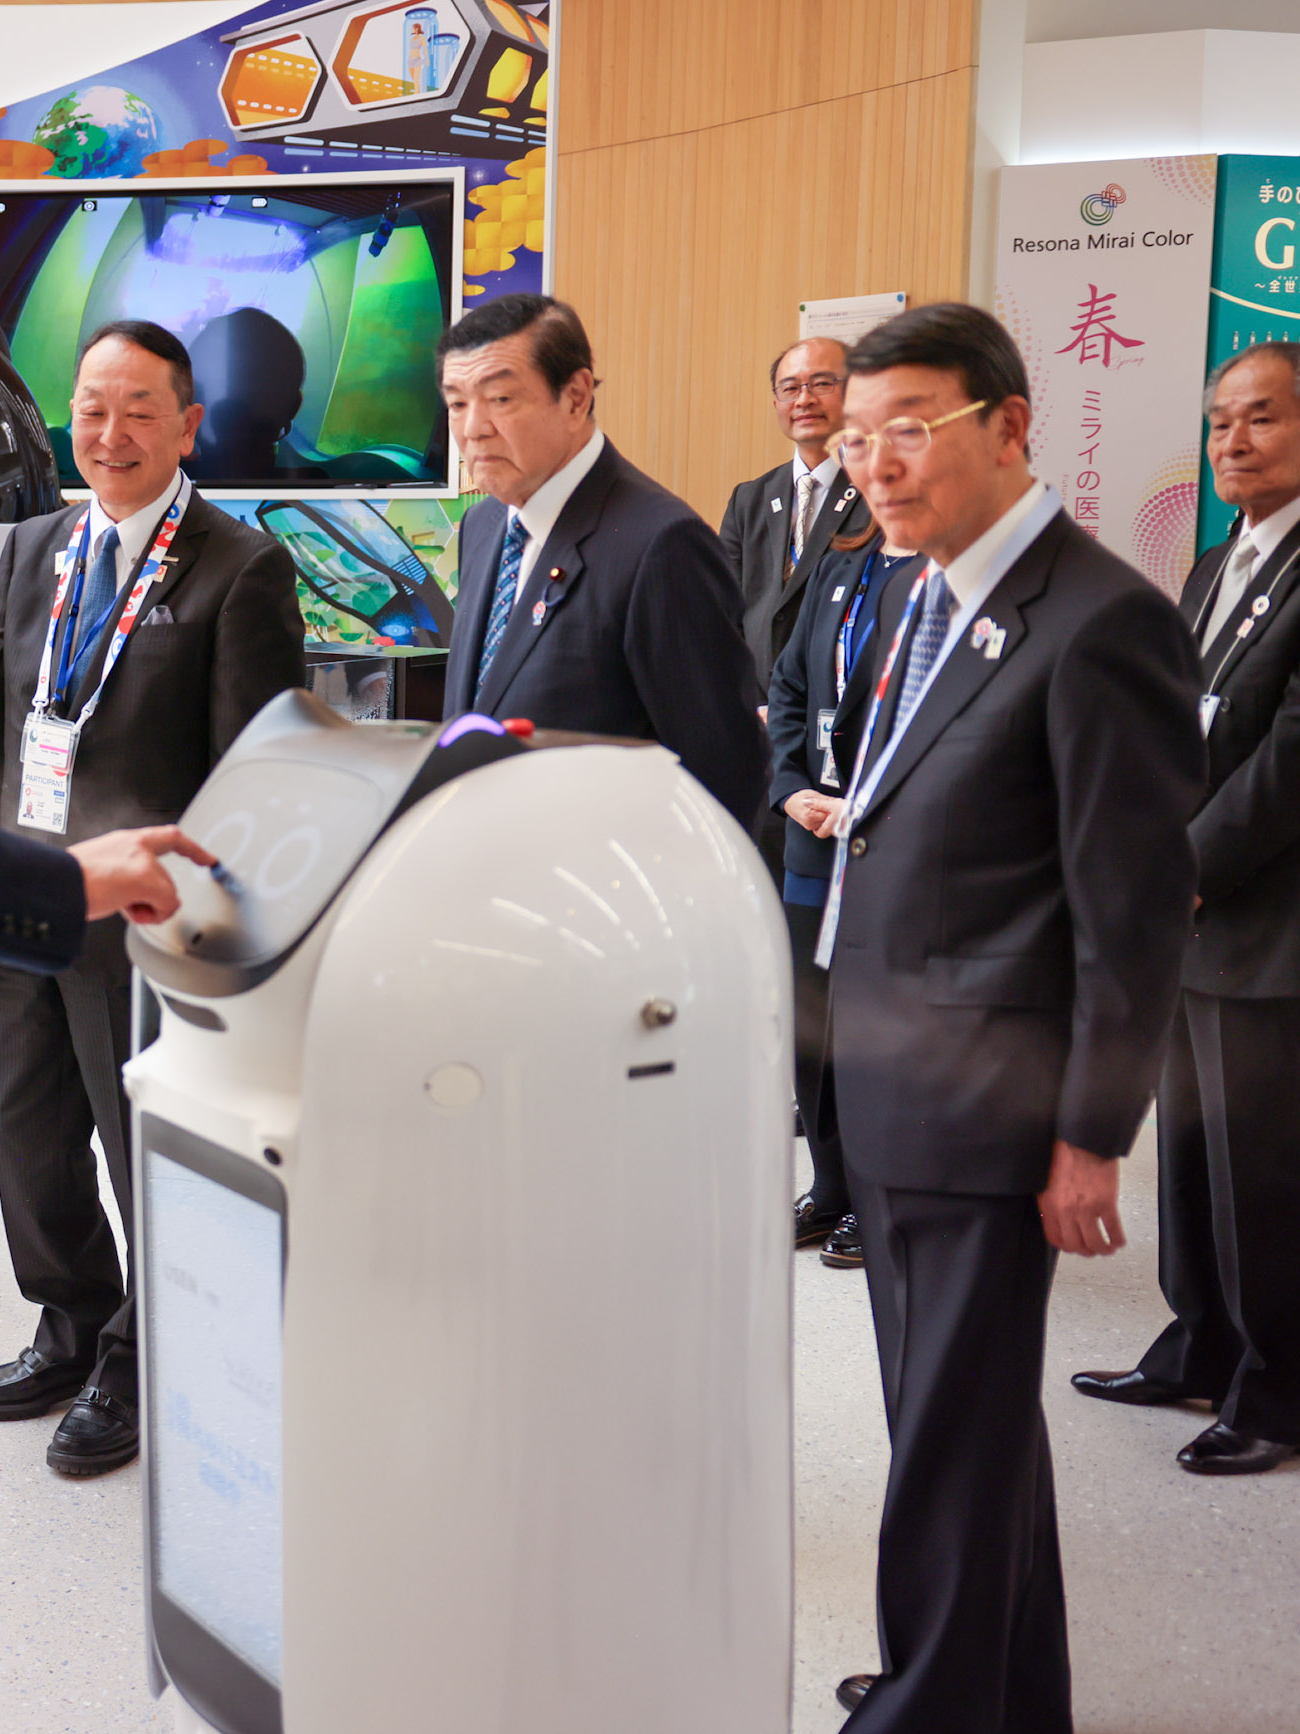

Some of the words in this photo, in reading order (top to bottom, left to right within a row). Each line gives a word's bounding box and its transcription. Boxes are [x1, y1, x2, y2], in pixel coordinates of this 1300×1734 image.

[1013, 237, 1080, 252] Resona
[1087, 232, 1135, 249] Mirai
[1142, 230, 1194, 247] Color
[1255, 217, 1295, 269] G
[1054, 283, 1145, 368] 春
[25, 774, 64, 787] PARTICIPANT
